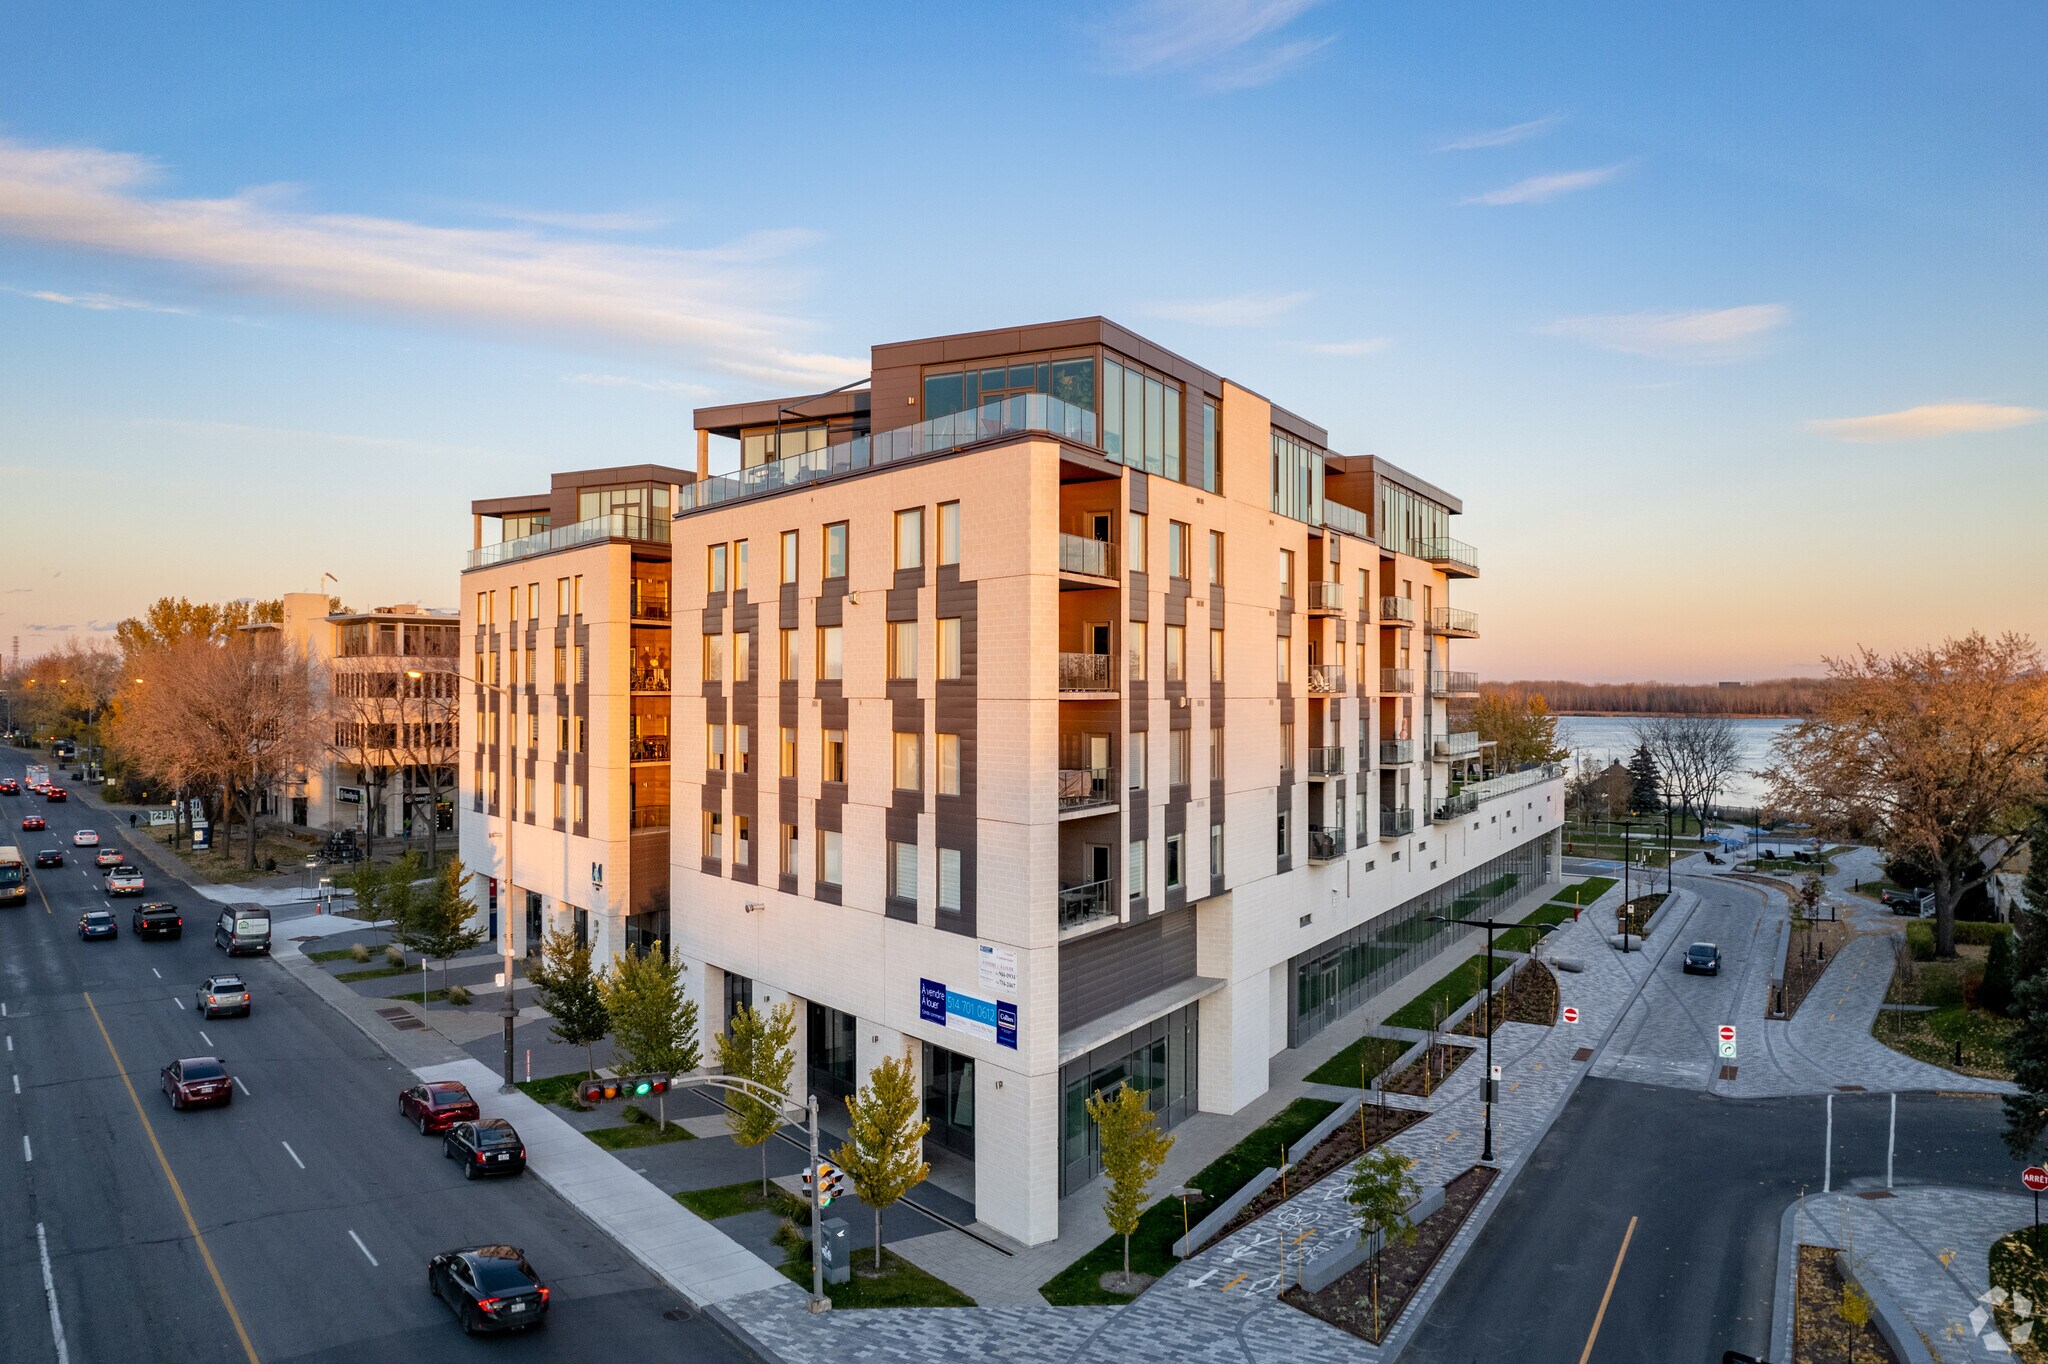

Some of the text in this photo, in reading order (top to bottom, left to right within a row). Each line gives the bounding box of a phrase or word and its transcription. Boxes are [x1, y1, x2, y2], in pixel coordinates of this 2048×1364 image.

[926, 988, 945, 1001] vendre
[926, 997, 939, 1009] louer
[947, 996, 960, 1010] 514
[962, 1000, 974, 1015] 701
[977, 1004, 995, 1021] 0612
[2024, 1174, 2048, 1184] ARRÊT
